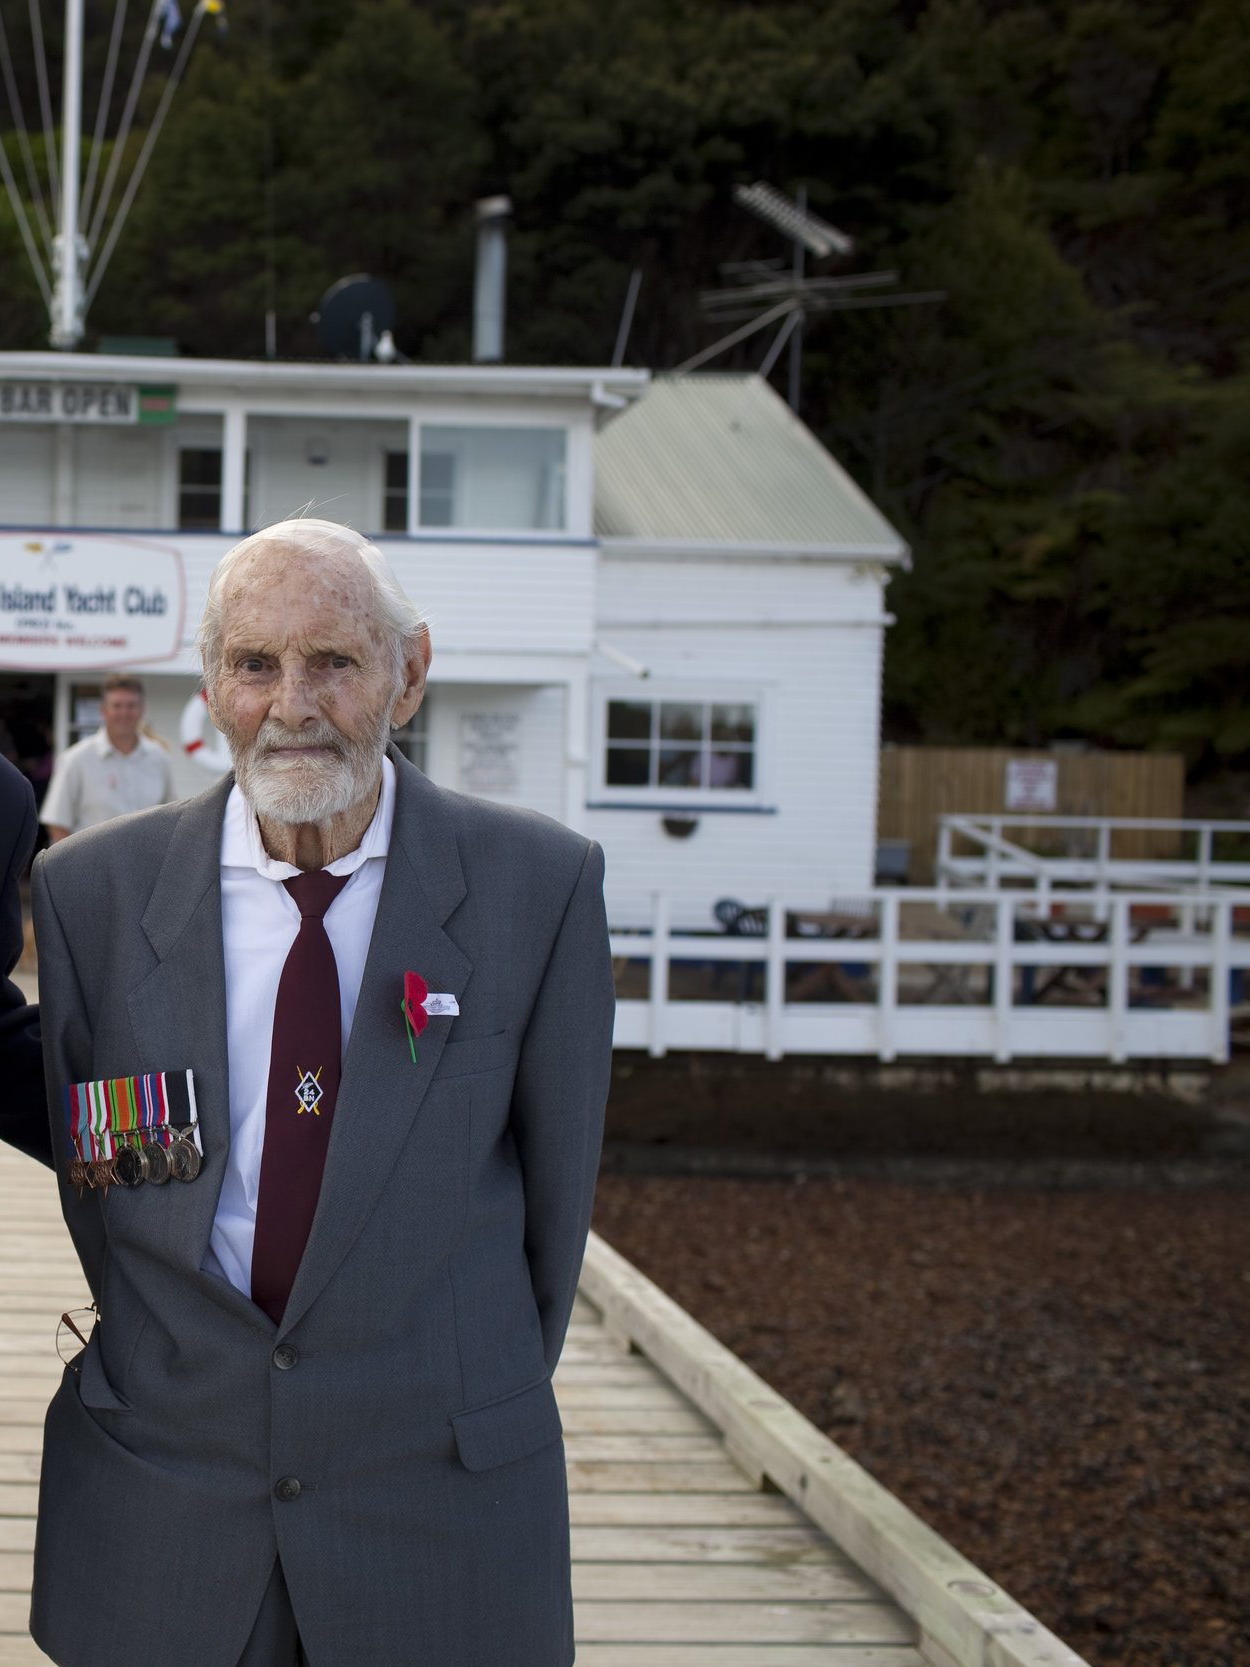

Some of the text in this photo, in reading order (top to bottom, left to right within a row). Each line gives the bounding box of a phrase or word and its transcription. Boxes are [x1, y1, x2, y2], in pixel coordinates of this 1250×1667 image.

[0, 384, 130, 416] BAR OPEN
[64, 586, 116, 615] Yacht
[124, 587, 167, 616] Club
